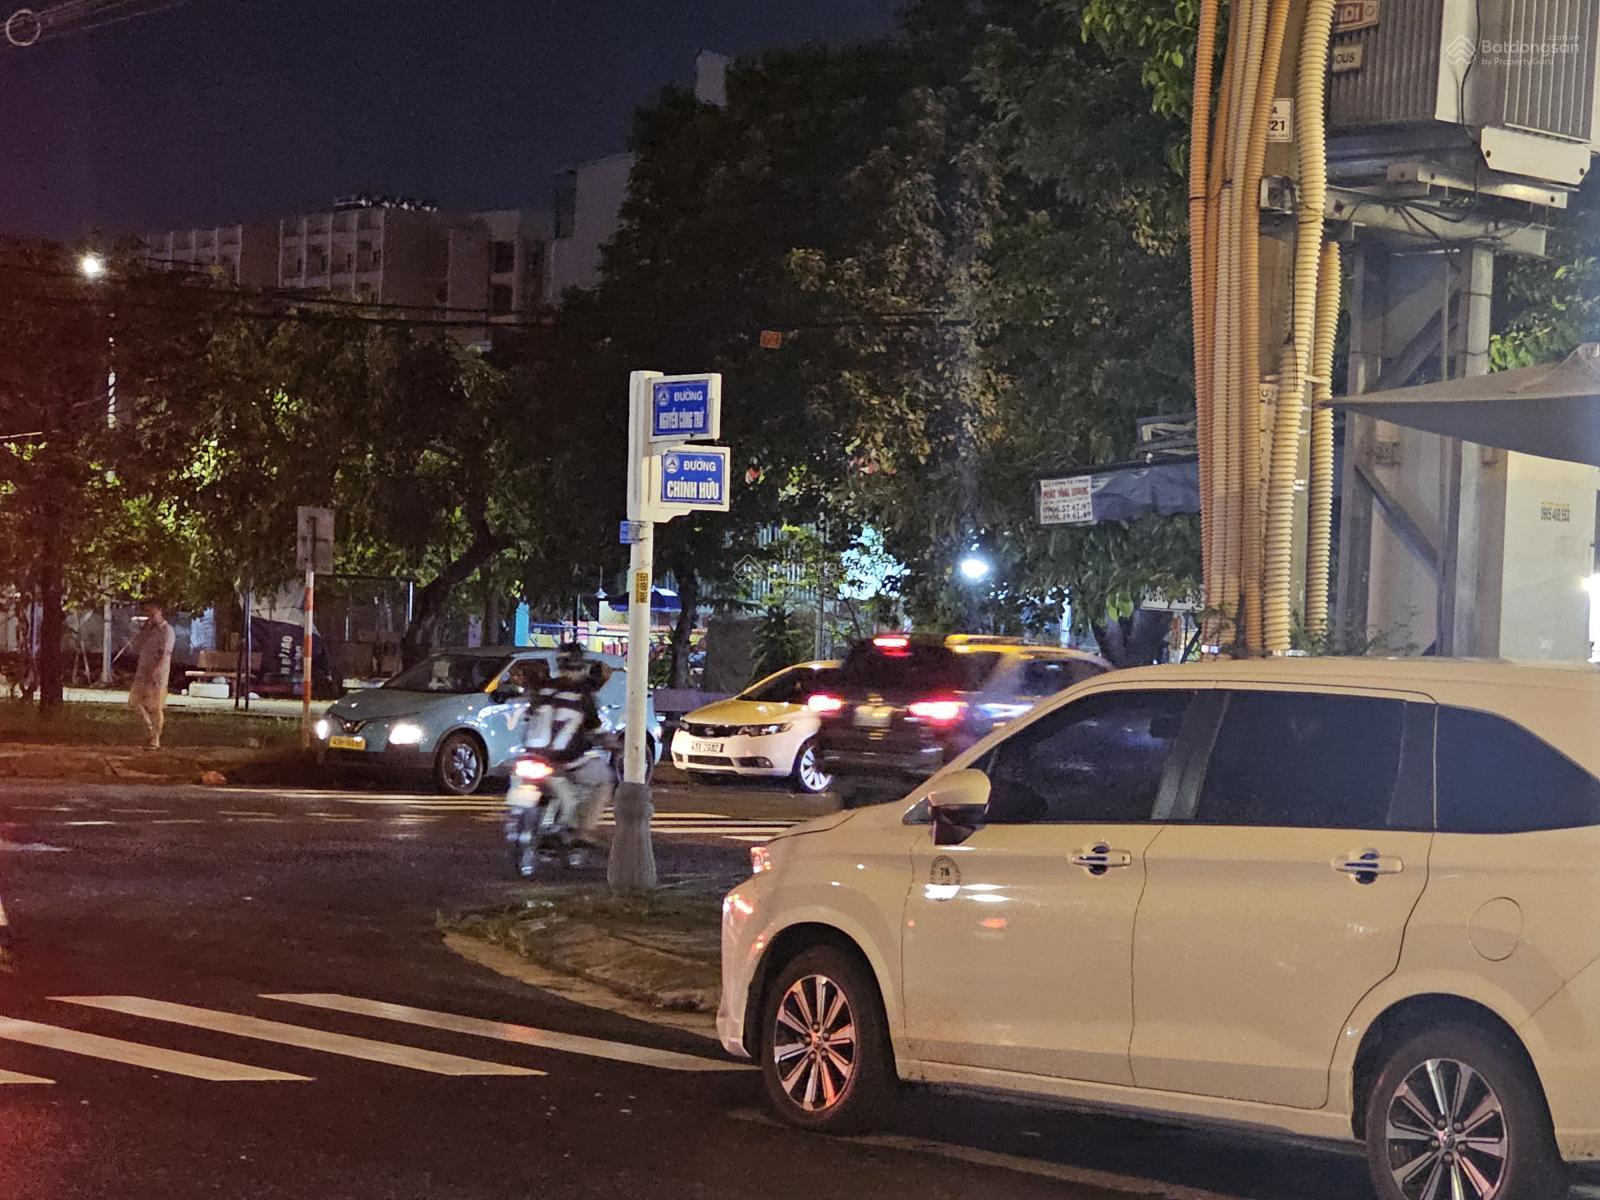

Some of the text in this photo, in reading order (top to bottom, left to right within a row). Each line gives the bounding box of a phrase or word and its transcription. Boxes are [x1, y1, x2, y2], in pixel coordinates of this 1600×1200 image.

[683, 457, 717, 472] ĐƯỜNG
[666, 476, 720, 500] CHÍNH HỮU
